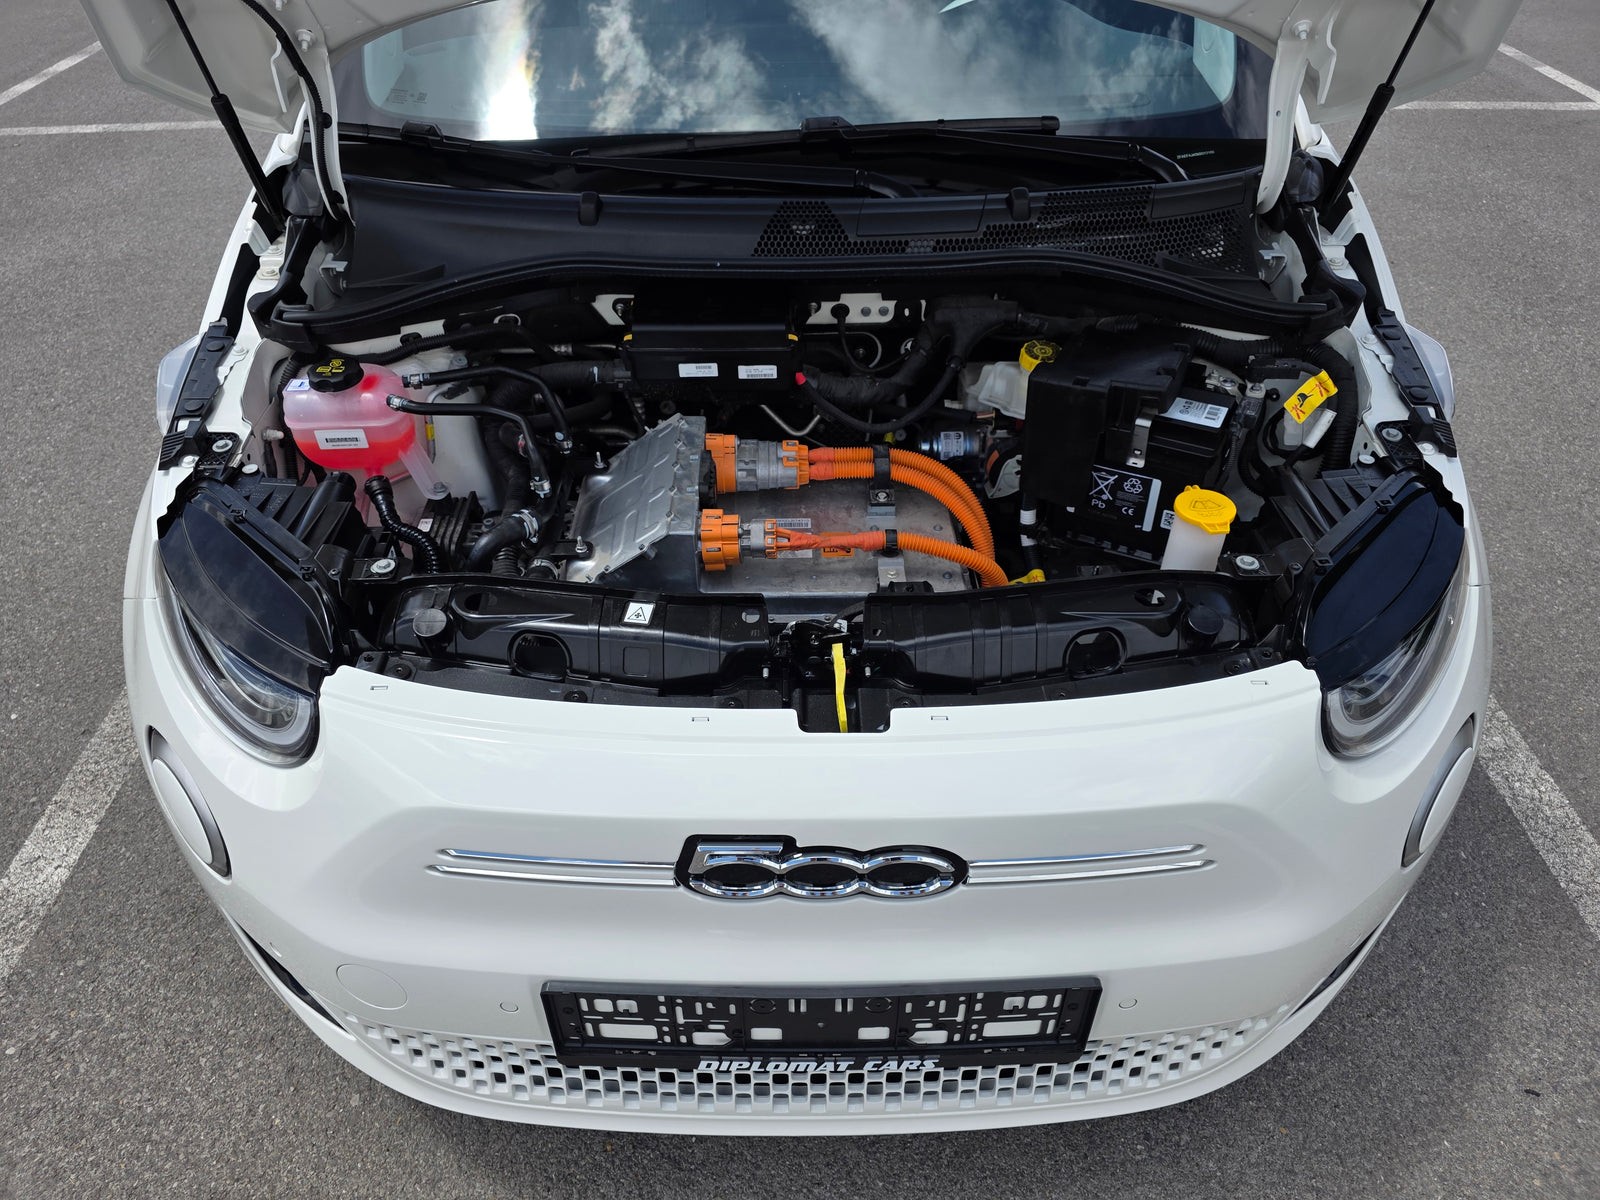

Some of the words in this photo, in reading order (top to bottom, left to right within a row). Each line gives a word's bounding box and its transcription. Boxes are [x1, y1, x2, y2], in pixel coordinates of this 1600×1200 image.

[1091, 498, 1106, 509] Pb
[687, 843, 956, 898] 500
[698, 1059, 854, 1072] DIPLOMAT
[864, 1059, 938, 1071] CARS
